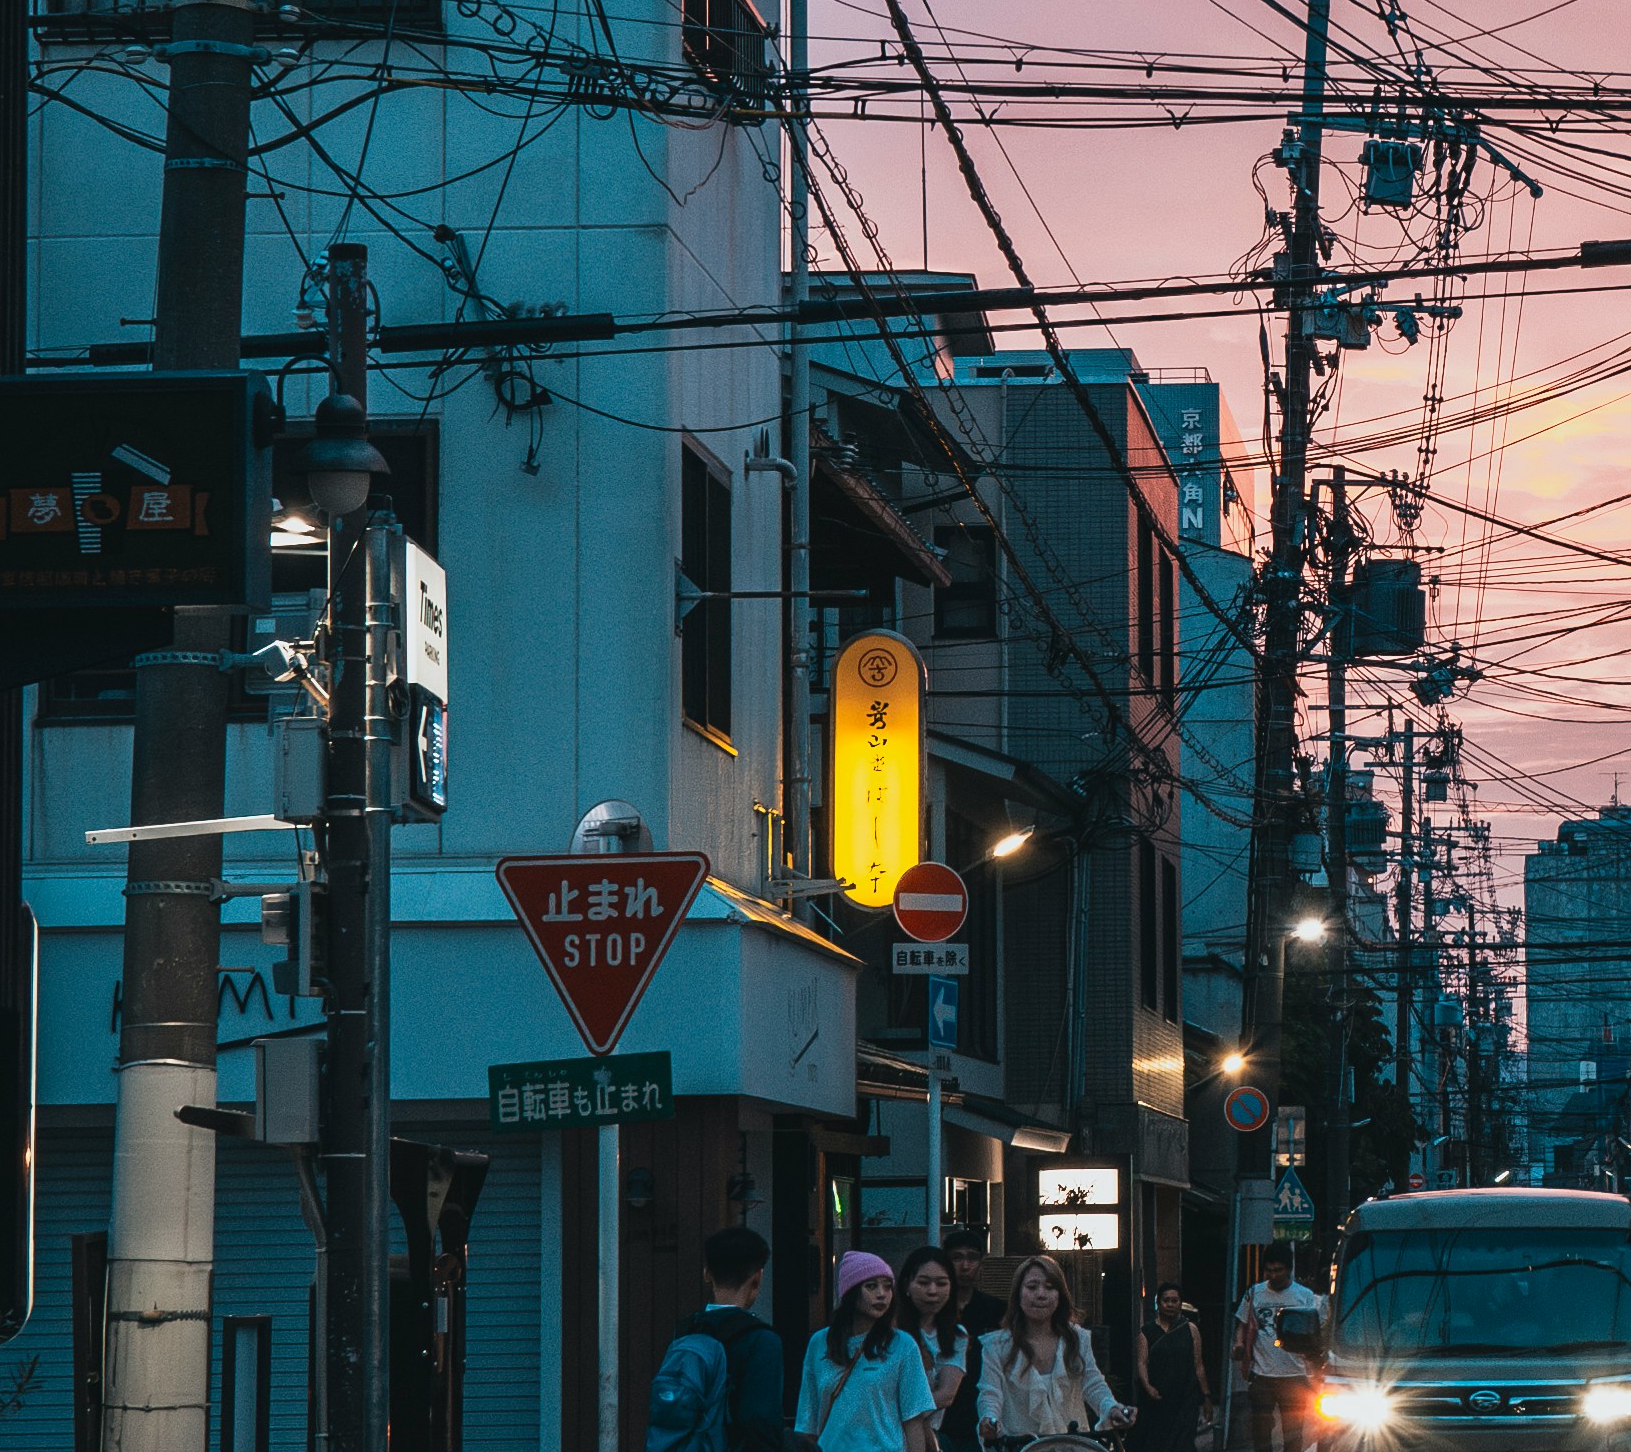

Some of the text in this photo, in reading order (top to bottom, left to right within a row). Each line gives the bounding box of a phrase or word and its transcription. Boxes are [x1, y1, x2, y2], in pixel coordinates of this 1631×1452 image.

[139, 491, 174, 523] 屋
[419, 579, 444, 639] Times
[541, 878, 665, 923] 止まれ
[563, 932, 646, 967] STOP
[896, 950, 966, 967] 自転車を除く
[498, 1080, 663, 1124] 自転車も止まれ
